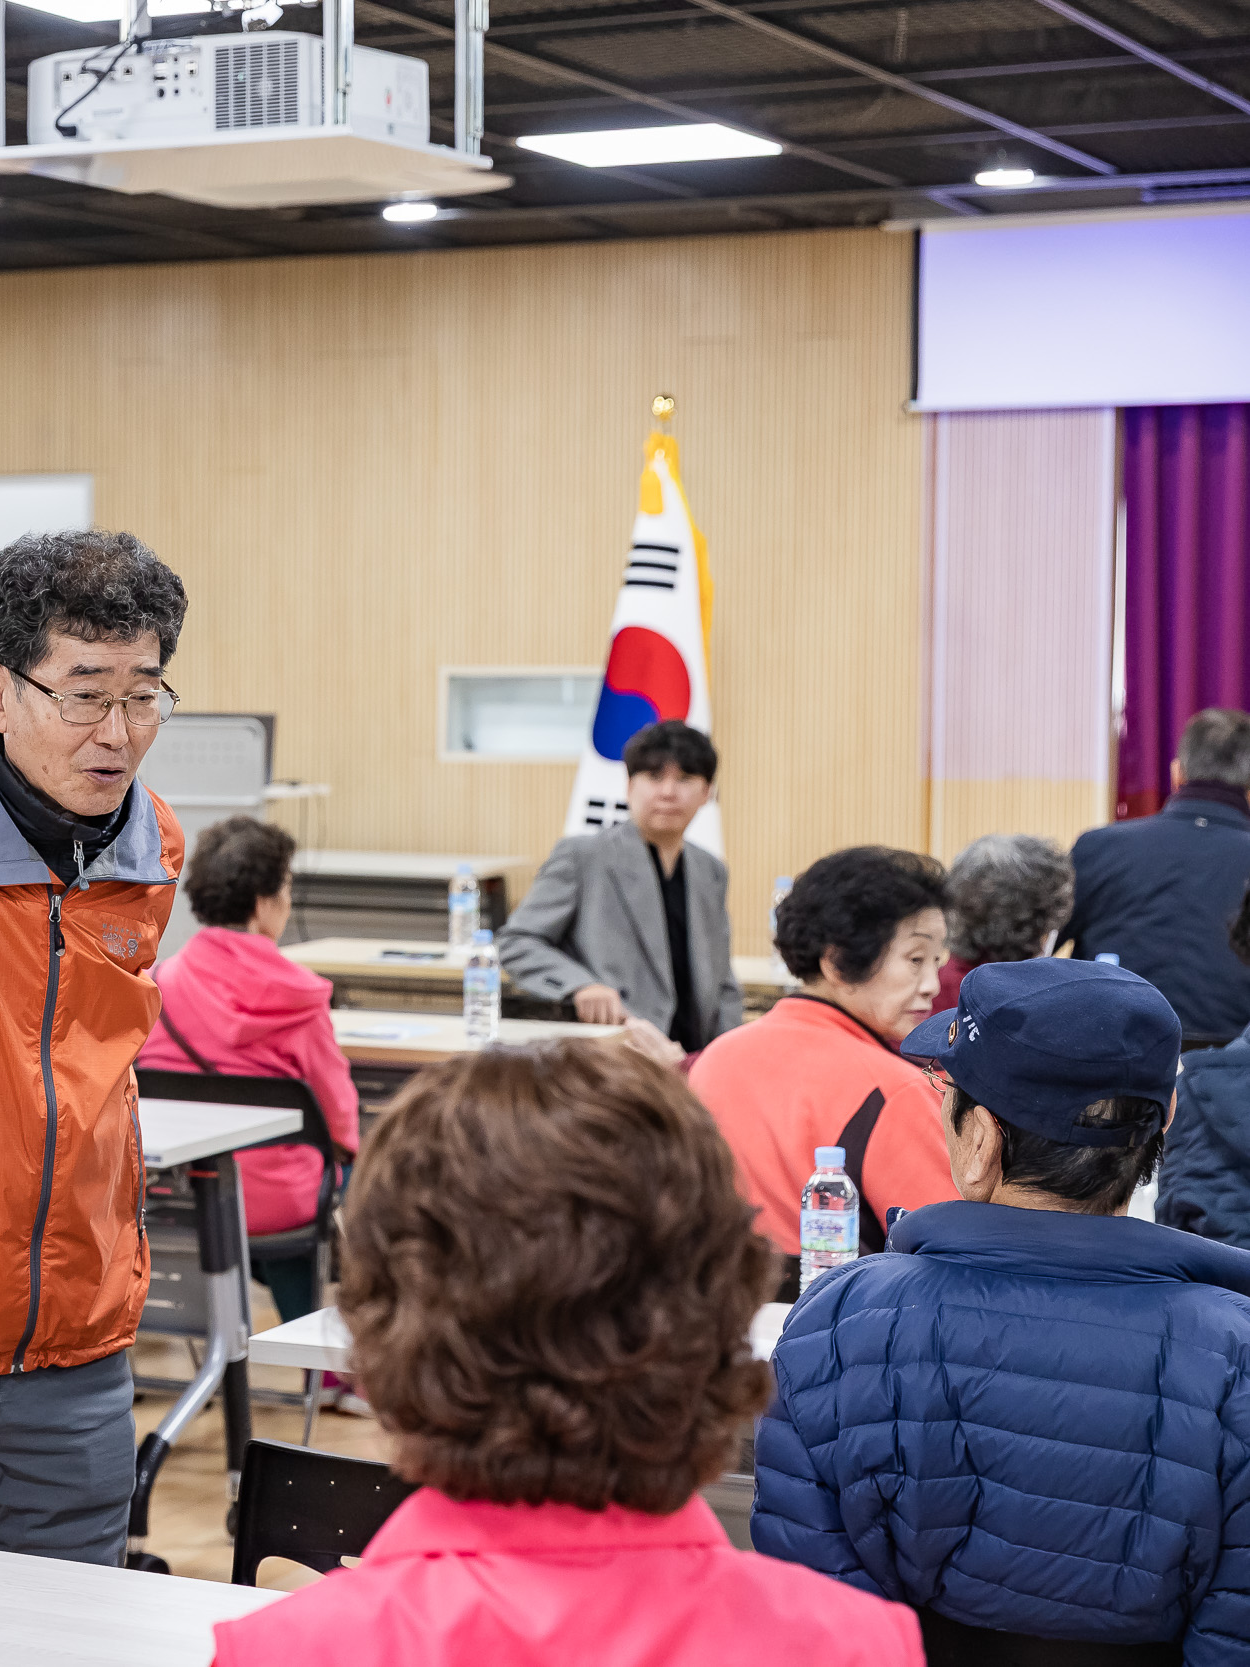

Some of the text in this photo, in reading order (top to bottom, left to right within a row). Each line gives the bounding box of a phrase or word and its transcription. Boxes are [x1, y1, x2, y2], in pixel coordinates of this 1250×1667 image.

[103, 923, 142, 938] MOUNTAIN
[103, 932, 123, 945] HARD
[108, 942, 126, 958] WEAR
